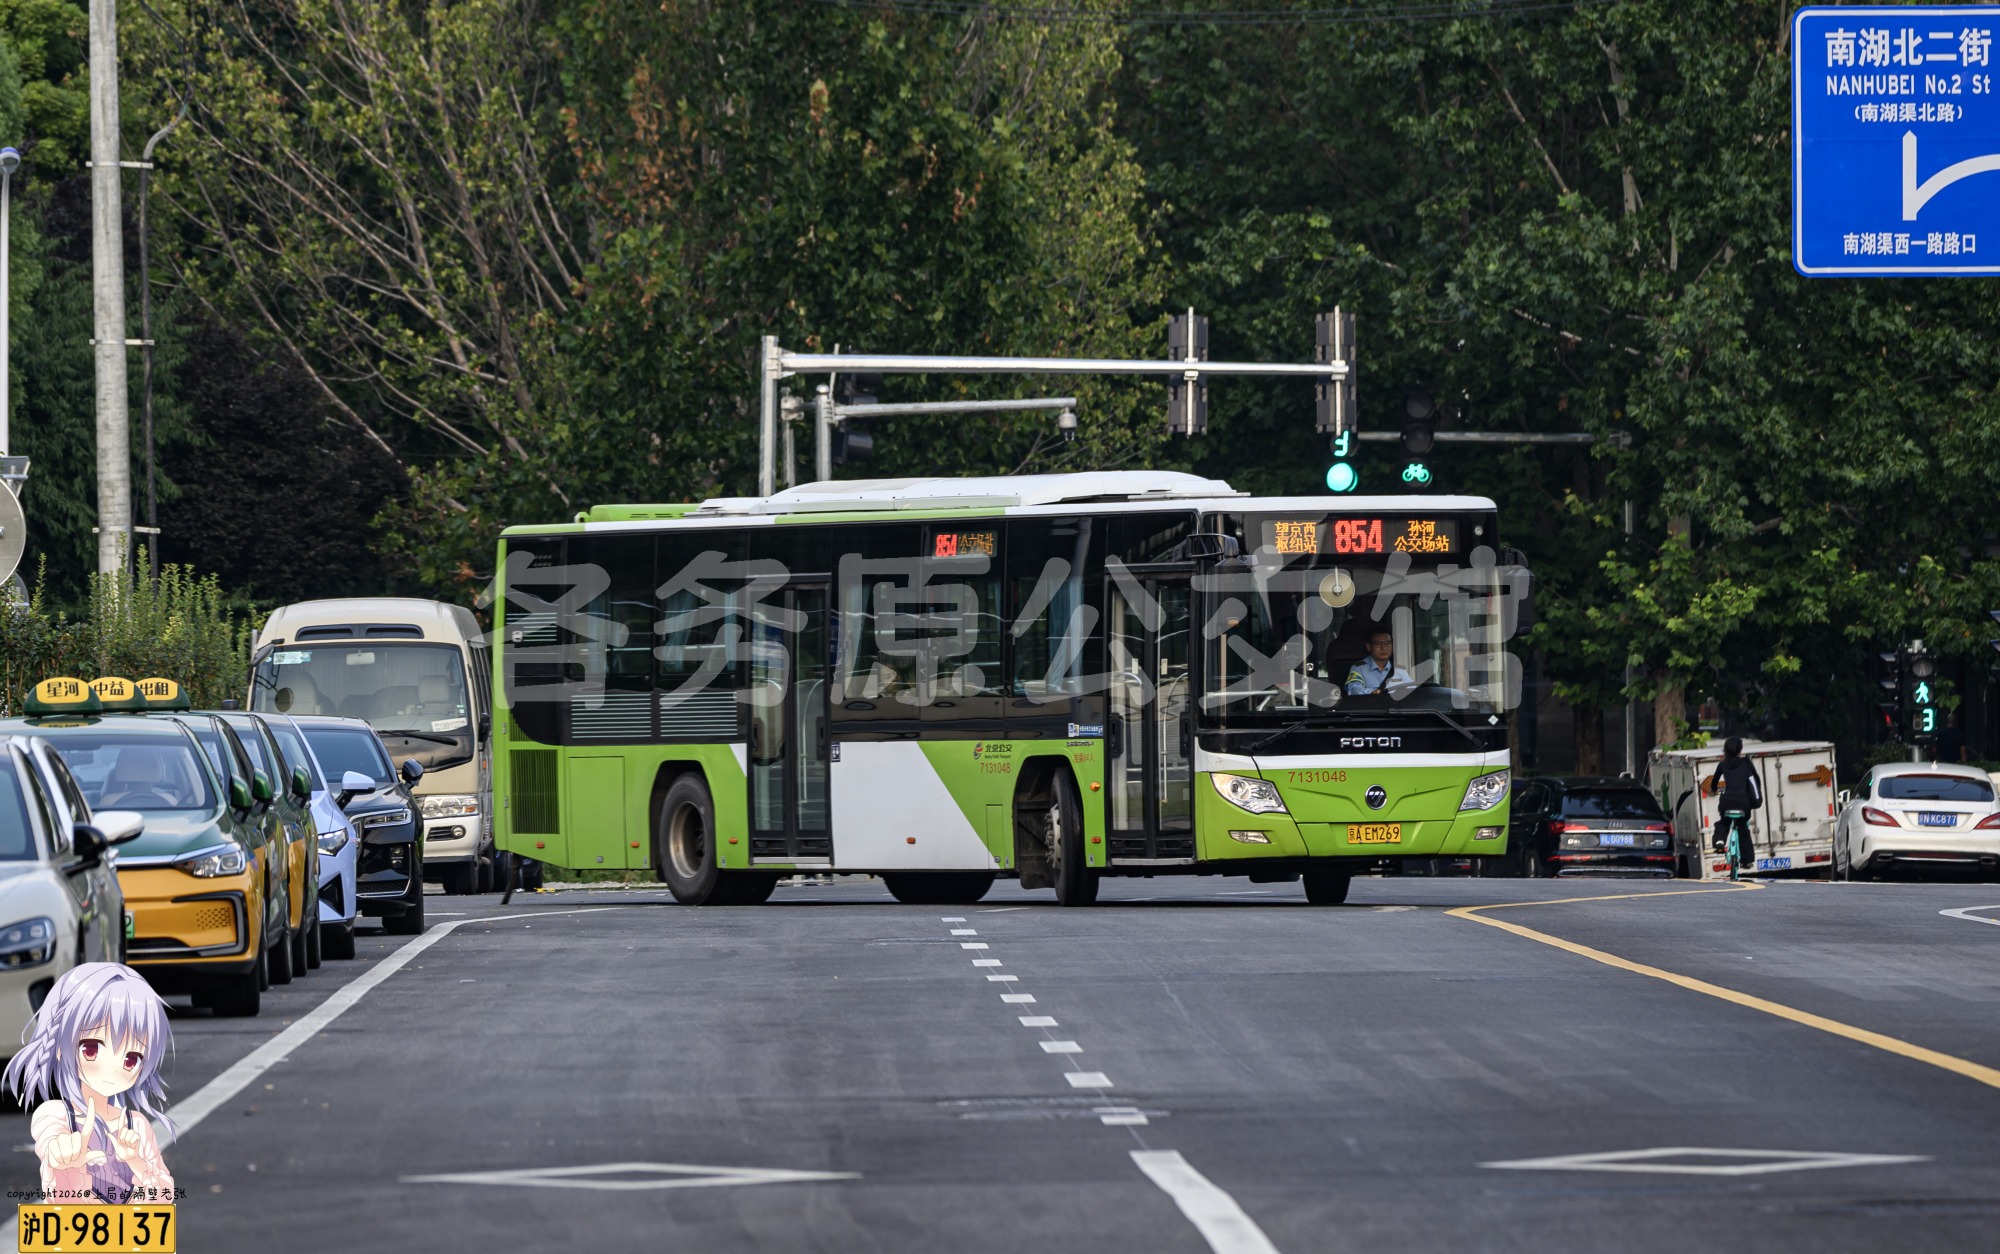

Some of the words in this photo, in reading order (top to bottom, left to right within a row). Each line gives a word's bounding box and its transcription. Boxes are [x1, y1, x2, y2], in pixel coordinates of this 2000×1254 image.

[1825, 27, 1992, 67] 南湖北二街
[1827, 75, 1915, 95] NANHUBEI
[1925, 74, 1962, 94] No.2
[1972, 74, 1991, 94] St
[1855, 102, 1963, 123] (南湖渠北路)
[1843, 232, 1976, 255] 南湖渠西一路路口
[1275, 521, 1317, 537] 望京西
[1335, 520, 1383, 553] 854
[1408, 520, 1436, 536] 孙河
[936, 534, 958, 557] 854
[1275, 536, 1317, 554] 枢纽站
[1394, 535, 1449, 552] 公交场站
[47, 681, 79, 697] 星河
[94, 681, 125, 696] 中益
[140, 682, 169, 696] 出租
[1922, 708, 1934, 731] 3
[1340, 736, 1401, 748] FOTON
[980, 762, 1011, 774] 7131048
[1288, 771, 1347, 784] 7131048
